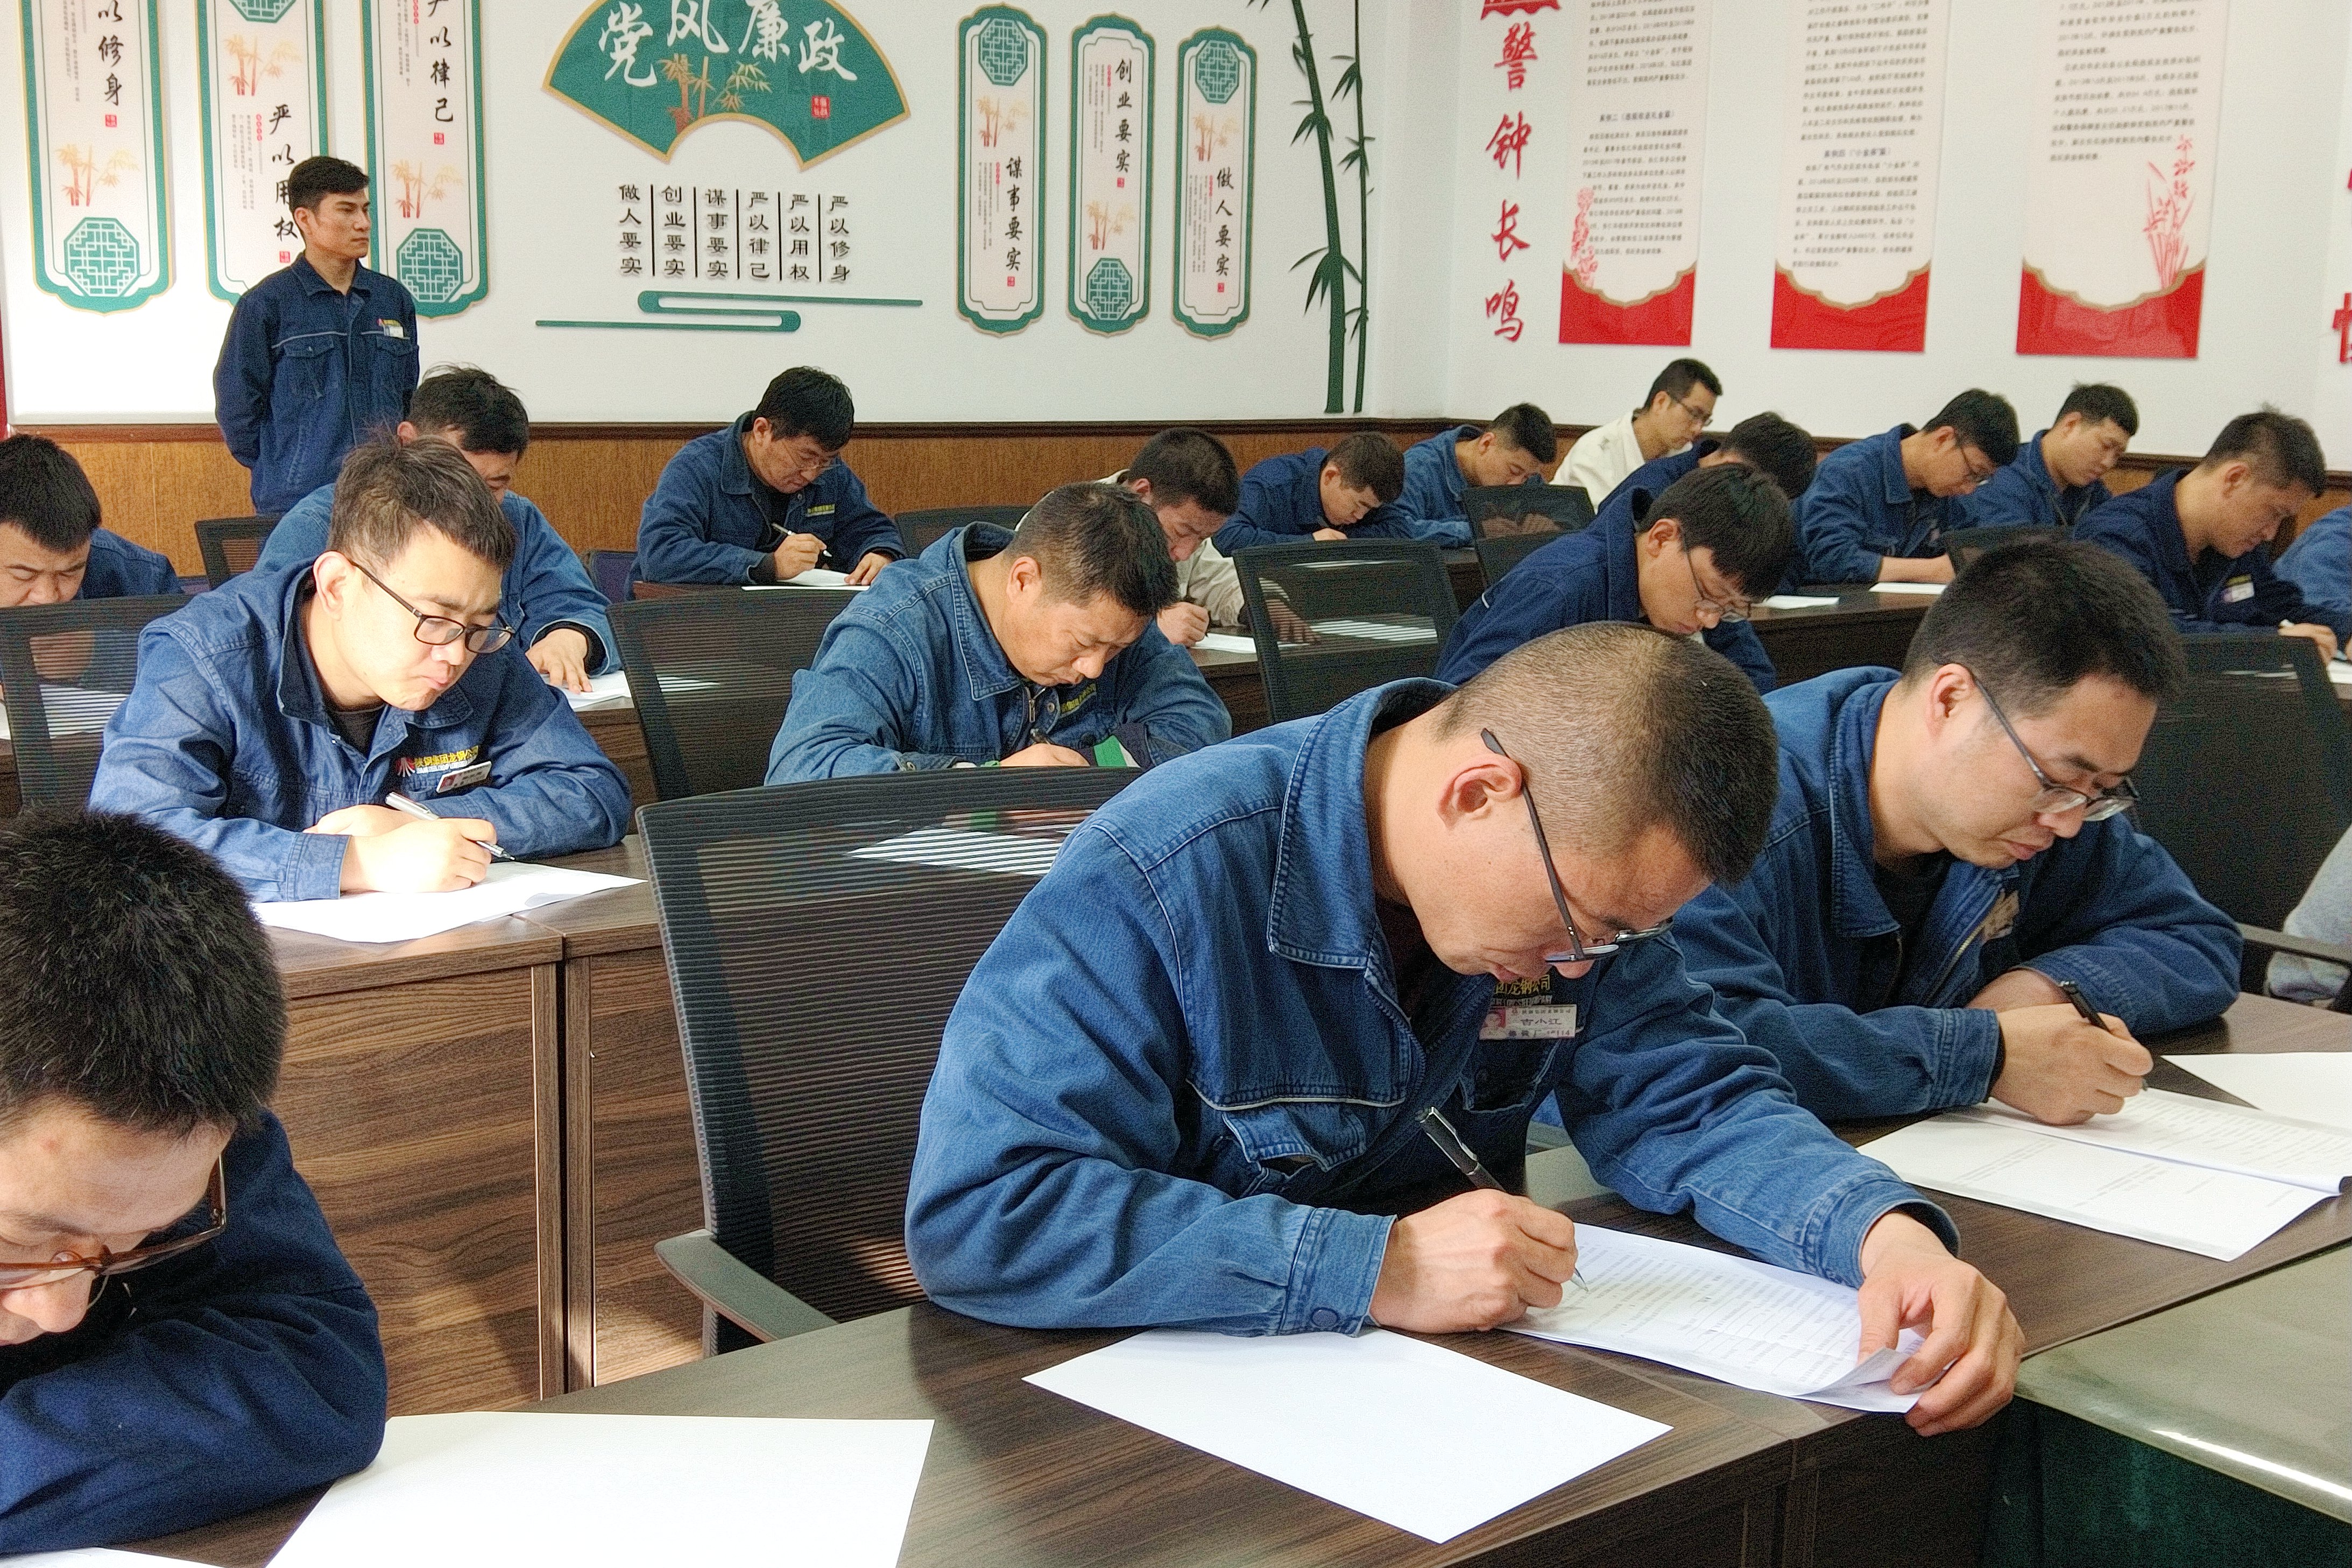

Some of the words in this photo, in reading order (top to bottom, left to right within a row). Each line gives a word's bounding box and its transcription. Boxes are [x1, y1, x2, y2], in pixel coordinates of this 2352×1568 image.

[598, 0, 858, 86] 党风廉政
[1115, 58, 1132, 173] 创业要实
[269, 104, 299, 242] 严以用权
[1005, 156, 1022, 271] 谋事要实
[1485, 20, 1538, 343] 警钟长鸣
[619, 184, 642, 275] 做人要实
[662, 186, 686, 276] 创业要实
[705, 188, 729, 277] 谋事要实
[748, 192, 770, 279] 严以律己
[789, 194, 810, 280] 严以用权
[830, 195, 851, 281] 严以修身
[1215, 166, 1234, 277] 做人要实
